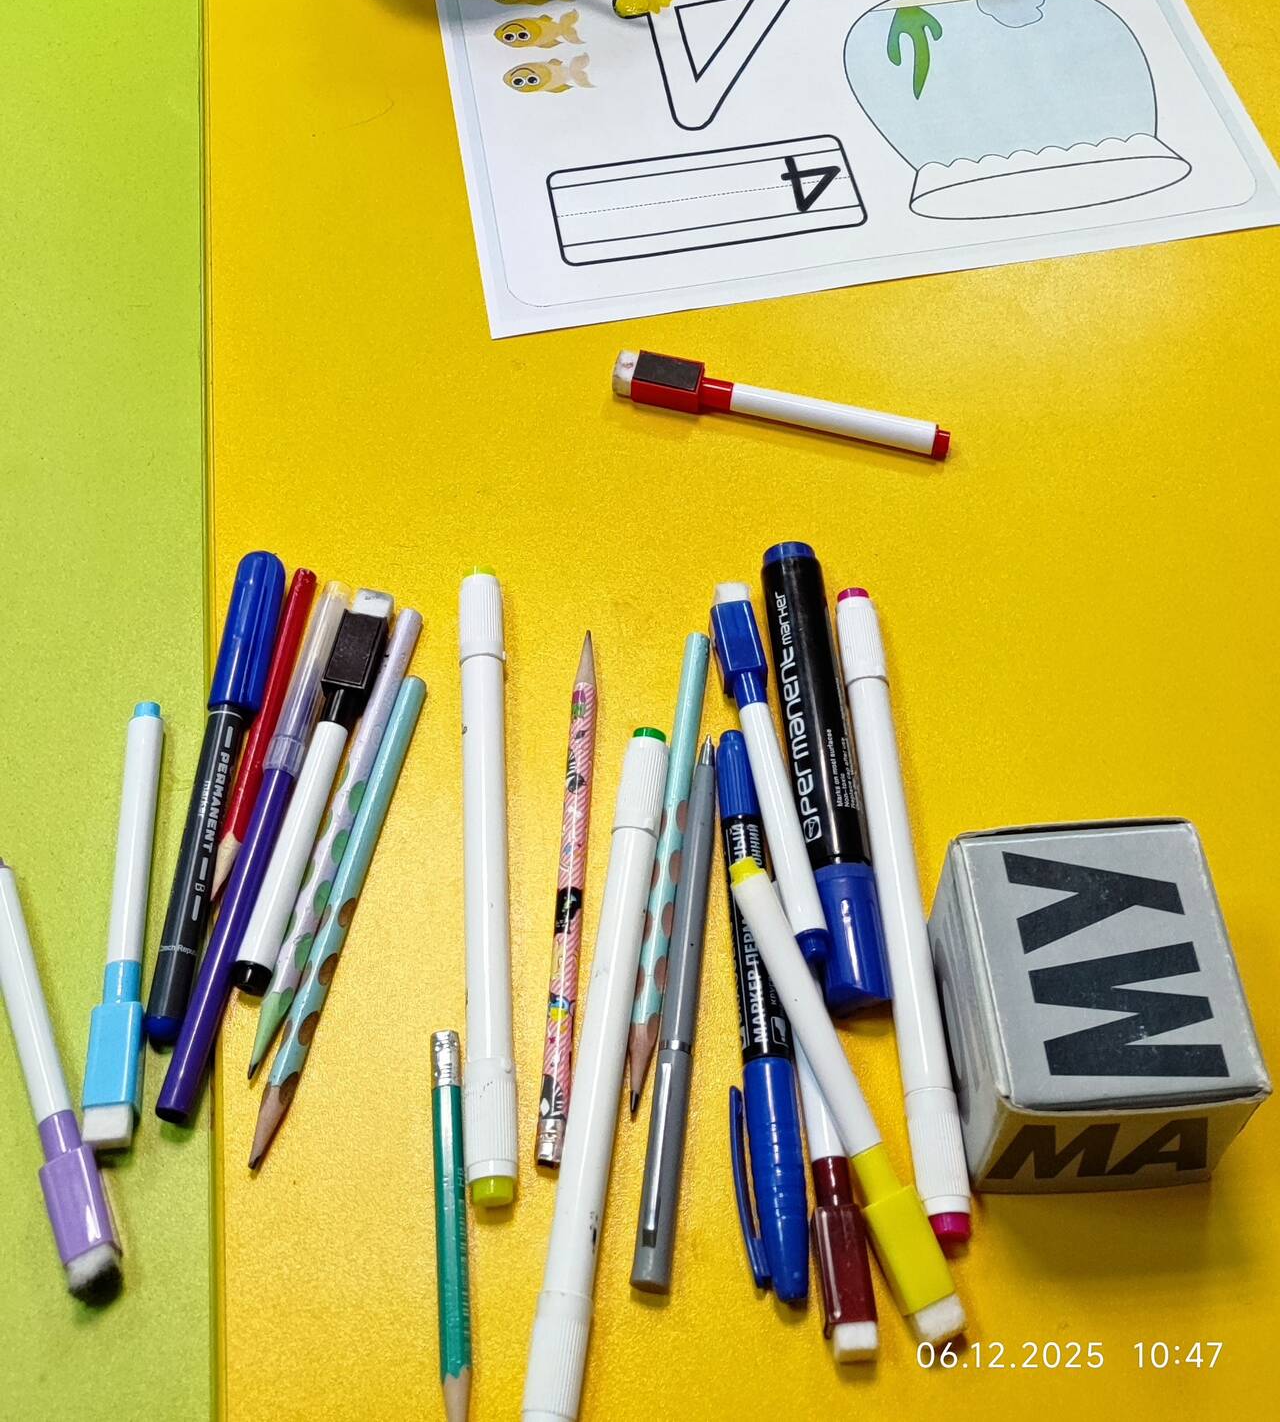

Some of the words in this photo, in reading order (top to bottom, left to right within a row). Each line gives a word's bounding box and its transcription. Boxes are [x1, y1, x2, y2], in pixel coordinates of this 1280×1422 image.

[781, 157, 841, 212] 4
[198, 780, 211, 817] marker
[202, 751, 231, 854] PERMANENT
[748, 969, 768, 1043] МАРКЕР
